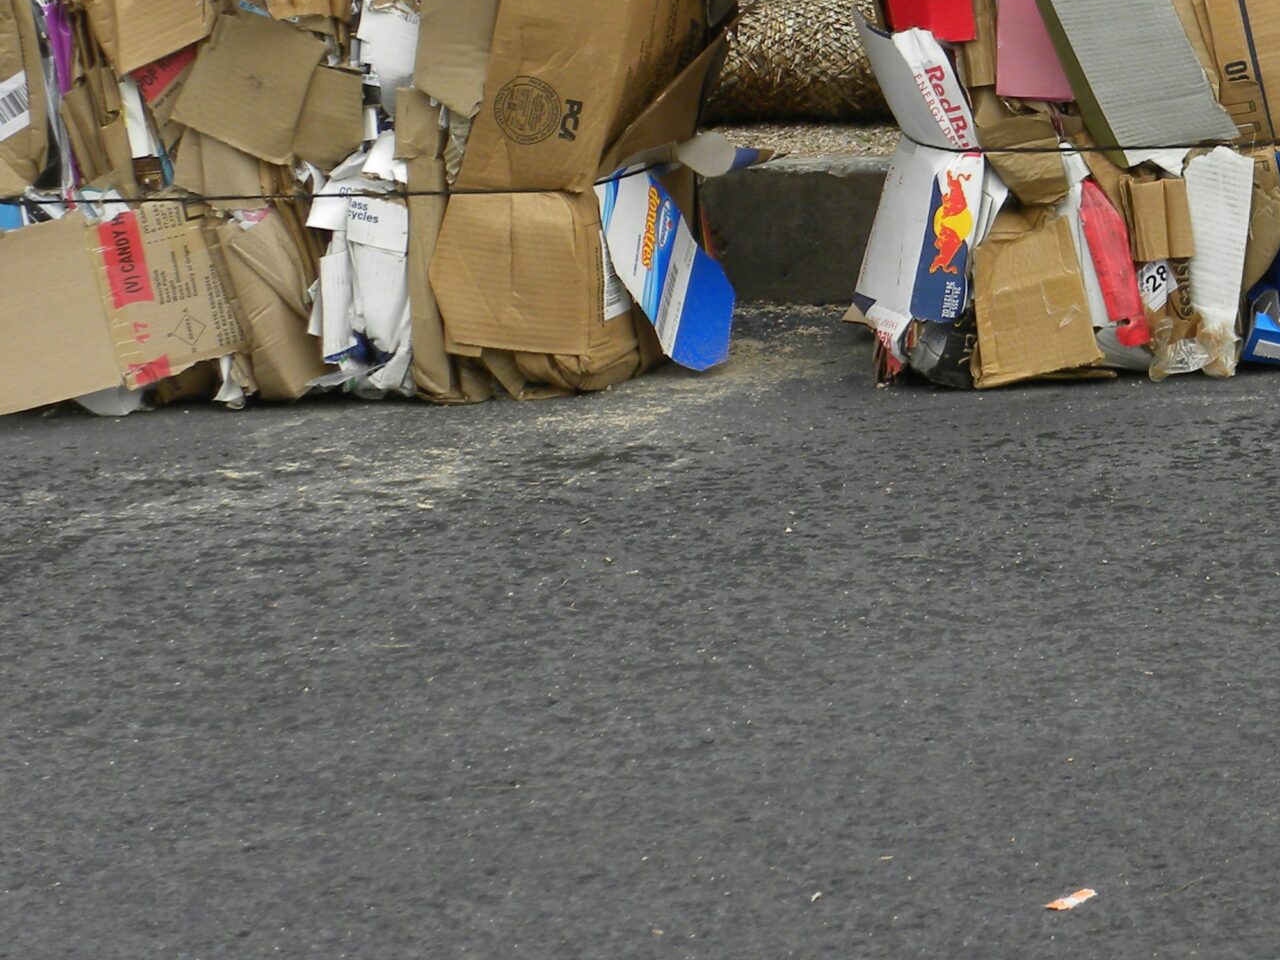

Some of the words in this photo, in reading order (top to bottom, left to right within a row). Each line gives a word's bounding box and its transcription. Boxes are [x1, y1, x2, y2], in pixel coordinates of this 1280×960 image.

[913, 73, 945, 124] ENERGY
[925, 65, 961, 113] Red
[558, 99, 583, 142] PCA
[642, 186, 661, 271] donettes
[114, 230, 135, 273] CANDY
[125, 276, 143, 294] (V)
[1146, 265, 1167, 293] 28
